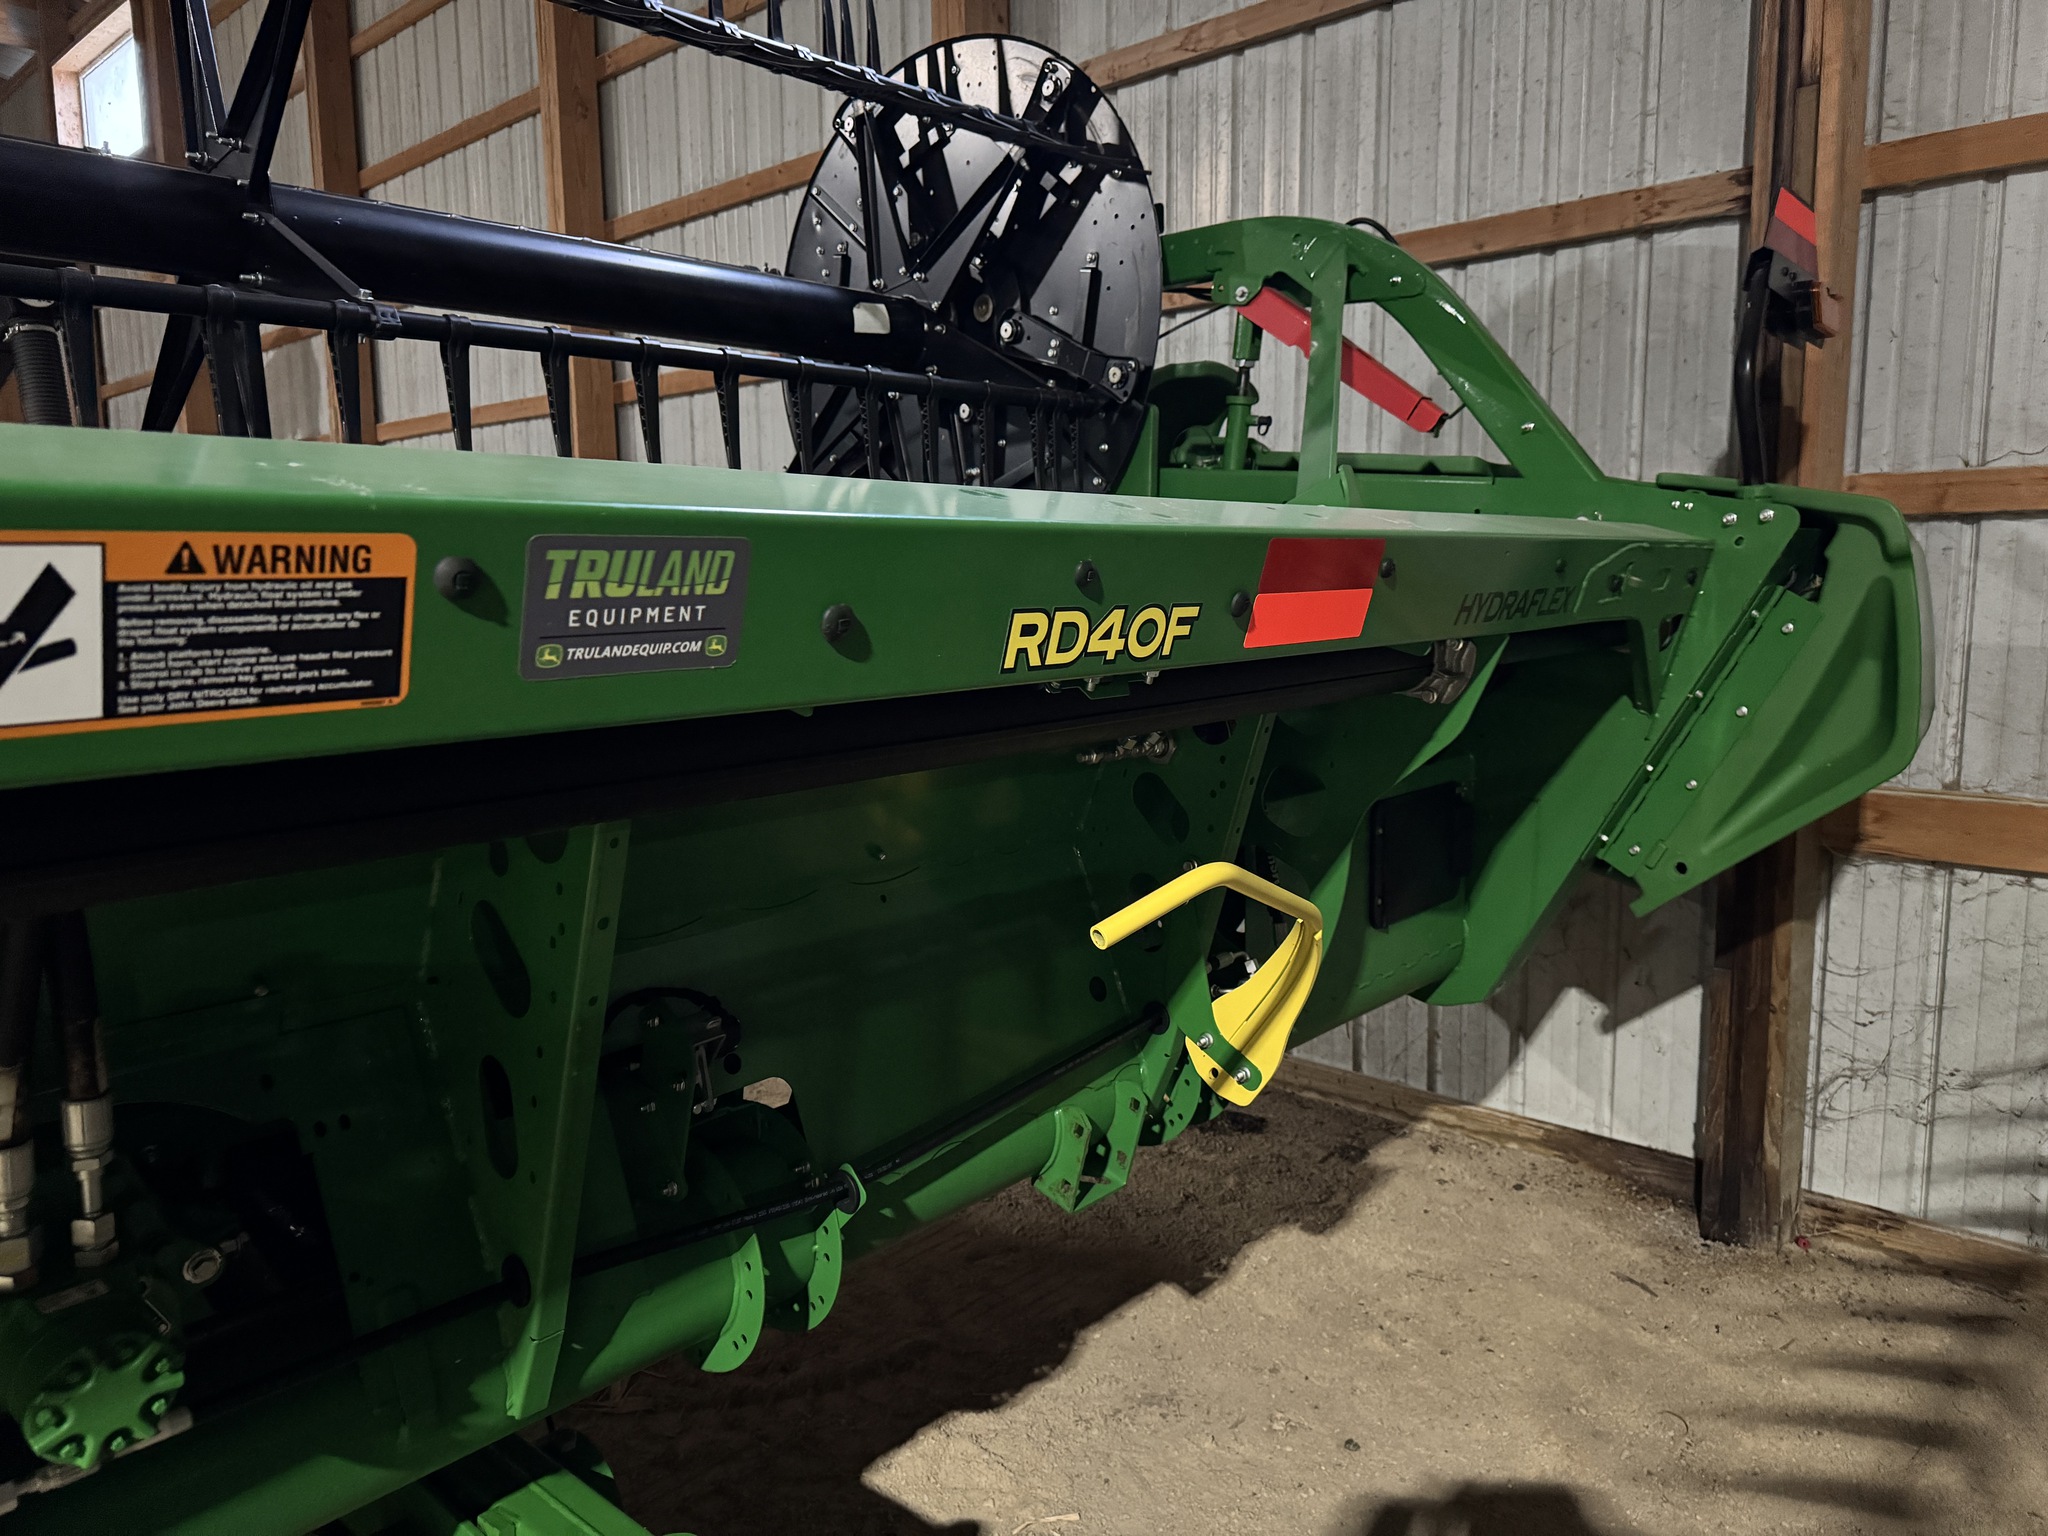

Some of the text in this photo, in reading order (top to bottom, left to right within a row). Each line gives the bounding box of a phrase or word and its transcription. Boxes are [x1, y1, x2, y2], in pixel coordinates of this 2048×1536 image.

[214, 544, 371, 574] WARNING
[545, 550, 736, 599] TRULAND
[569, 605, 706, 628] EQUIPMENT
[1454, 586, 1576, 625] HYDRAFLEX
[566, 641, 702, 661] TRULANDEQUIP.COM
[1001, 603, 1202, 673] RD40F
